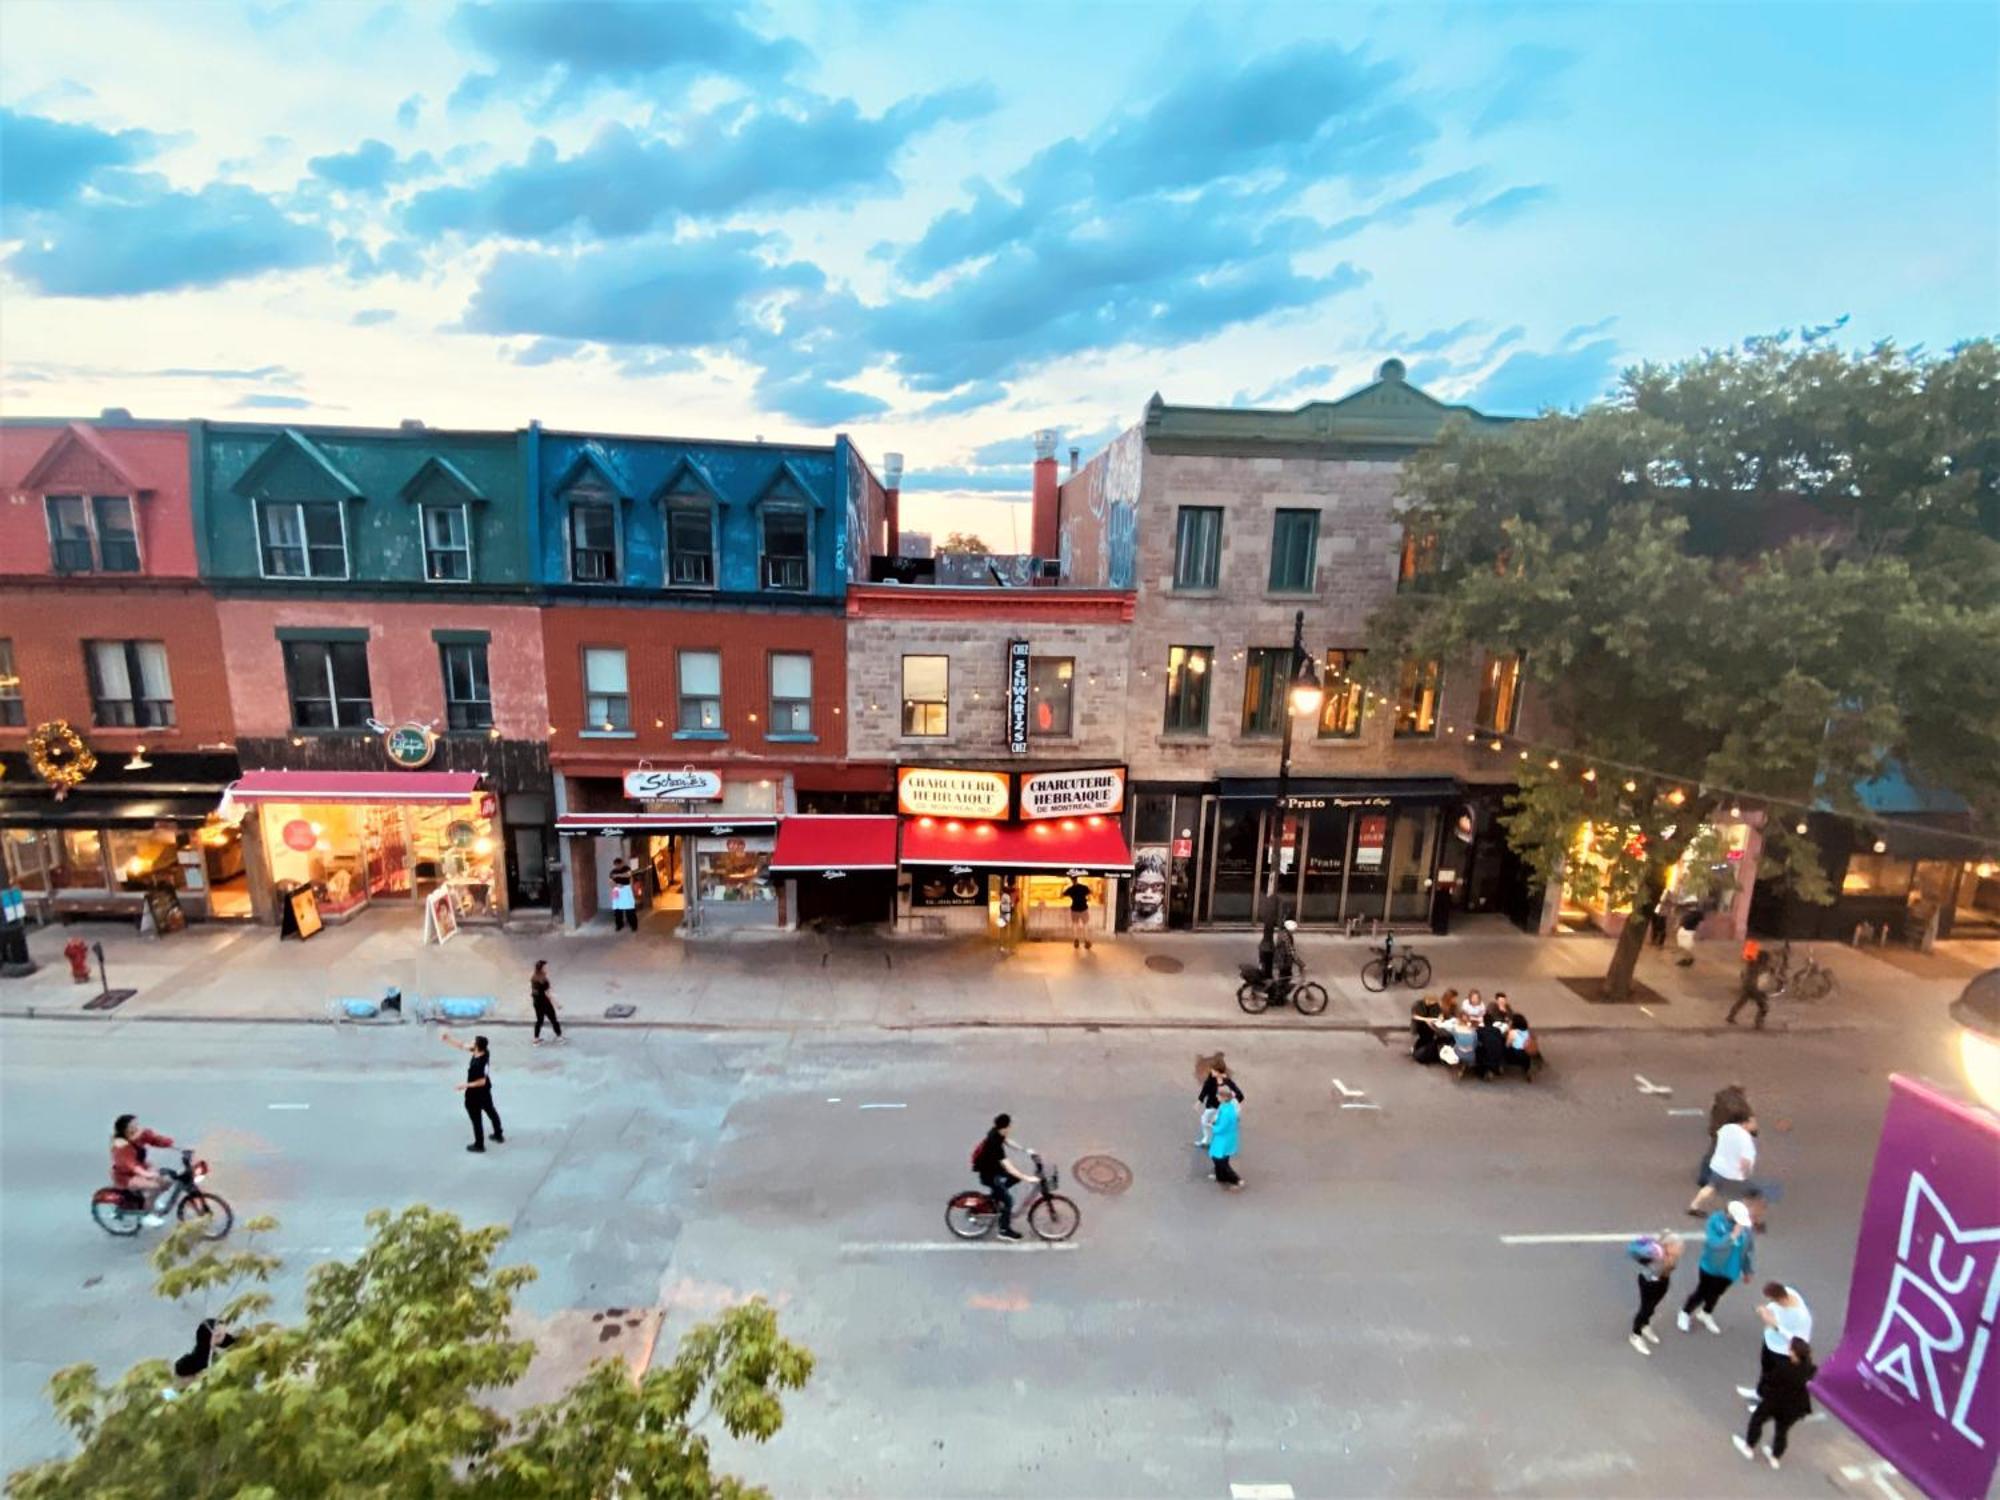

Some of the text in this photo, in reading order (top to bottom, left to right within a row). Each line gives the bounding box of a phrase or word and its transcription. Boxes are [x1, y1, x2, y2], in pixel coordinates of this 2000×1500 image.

[908, 777, 999, 792] CHARCUTERIE
[1030, 776, 1115, 792] CHARCUTERIE
[1034, 789, 1111, 805] HEBRAIQUE
[1288, 798, 1325, 809] Prato
[1036, 805, 1048, 813] DE
[1050, 803, 1092, 812] MONTREAL
[1310, 857, 1341, 867] Prato
